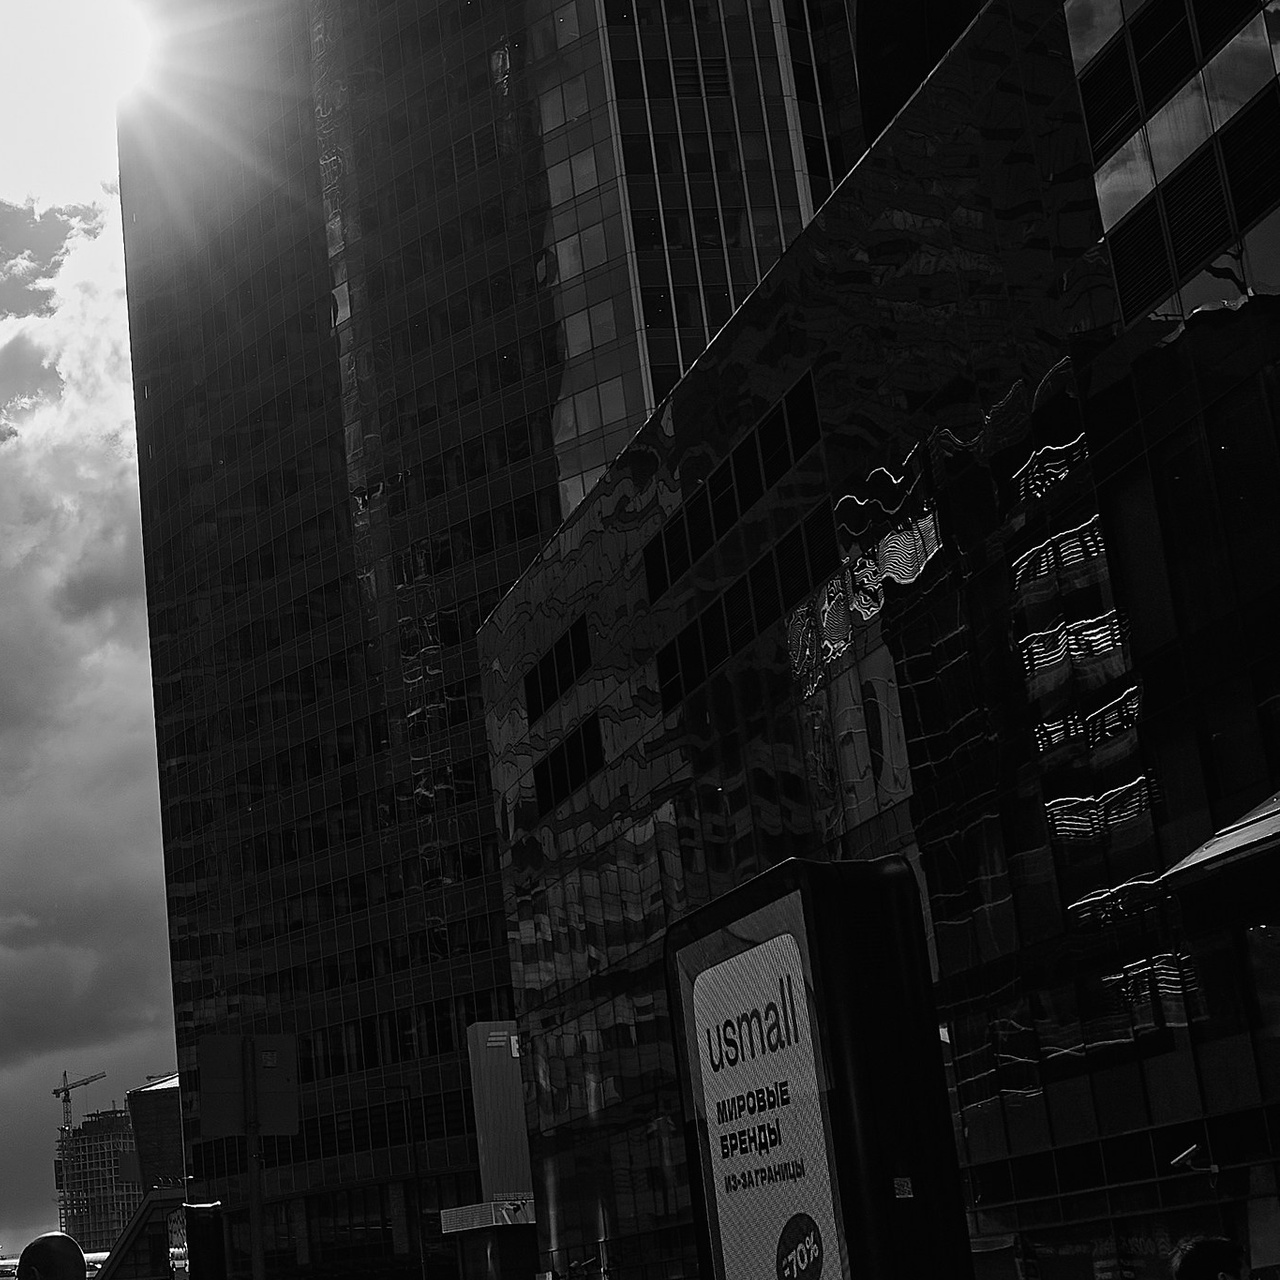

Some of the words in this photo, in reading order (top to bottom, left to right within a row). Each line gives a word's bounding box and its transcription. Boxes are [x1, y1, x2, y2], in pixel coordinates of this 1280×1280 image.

[707, 975, 799, 1074] usmall
[717, 1081, 791, 1125] МИРОВЫЕ
[720, 1118, 782, 1159] БРЕНДЫ
